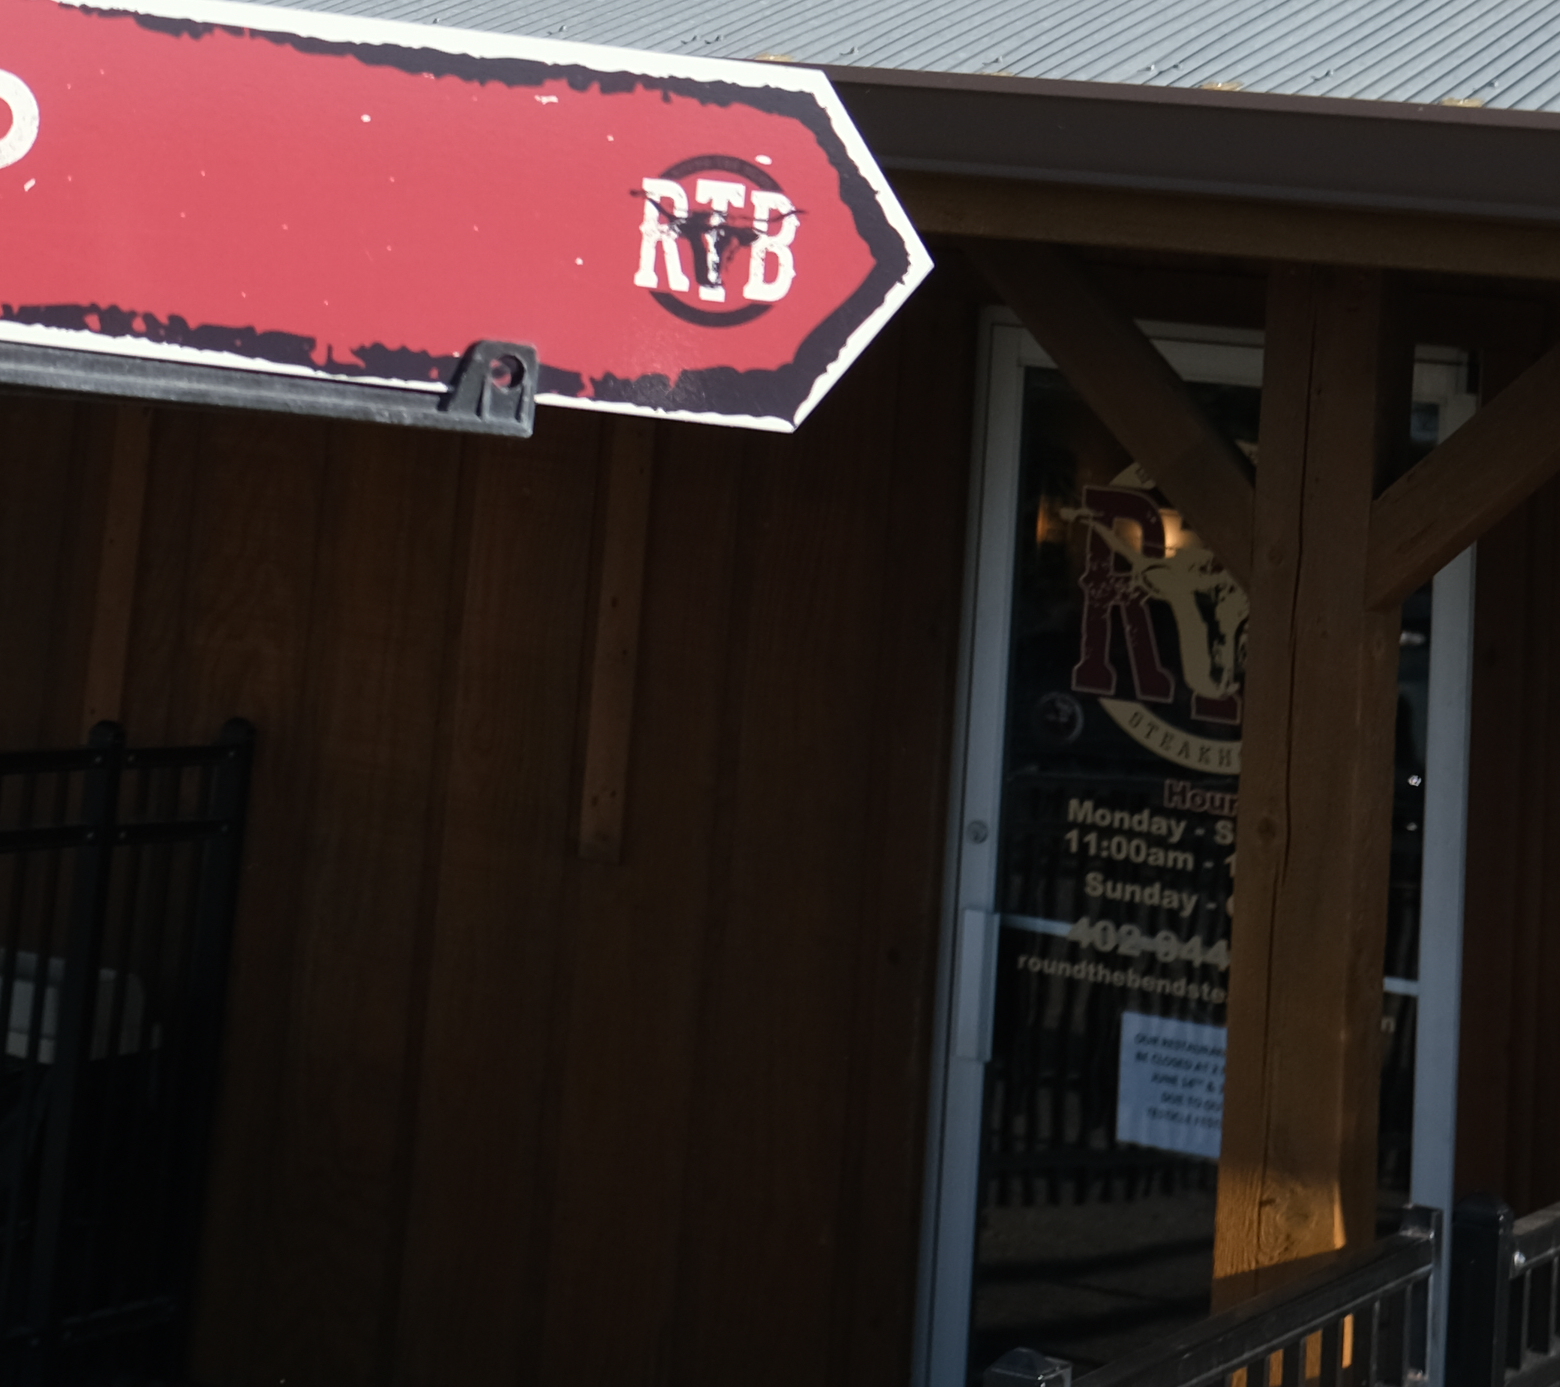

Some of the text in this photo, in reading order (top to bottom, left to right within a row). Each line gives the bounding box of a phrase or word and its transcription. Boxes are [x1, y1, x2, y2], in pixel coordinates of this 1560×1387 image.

[634, 177, 800, 302] RTB
[1128, 711, 1234, 769] STEAKH
[1067, 798, 1188, 844] Monday
[1214, 819, 1236, 846] S
[1163, 778, 1238, 816] Hour
[1064, 828, 1195, 872] 11:00am
[1224, 852, 1237, 878] 1
[1084, 871, 1199, 918] Sunday
[1066, 916, 1231, 973] 402-944
[1017, 953, 1229, 1005] roundthebendste
